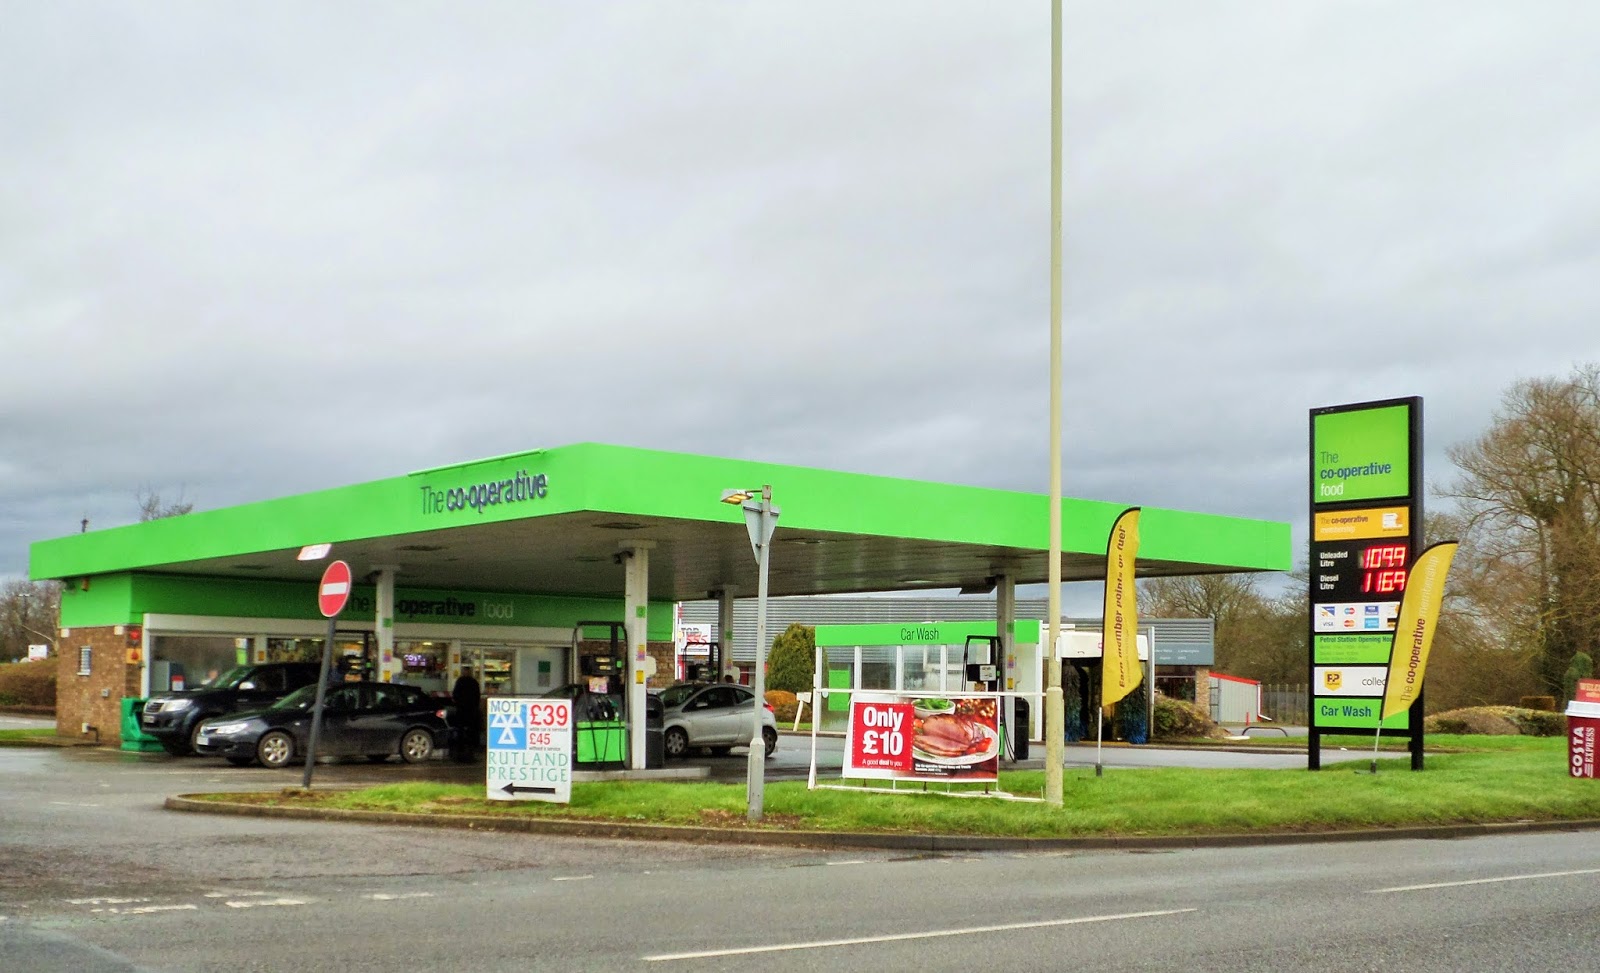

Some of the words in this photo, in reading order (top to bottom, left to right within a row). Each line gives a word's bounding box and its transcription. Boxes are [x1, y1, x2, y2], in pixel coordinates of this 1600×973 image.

[1320, 451, 1339, 464] The
[1320, 462, 1391, 480] co-operative
[421, 485, 444, 515] The
[446, 470, 548, 514] co-operative
[1320, 482, 1344, 497] food
[1331, 515, 1369, 524] co-operative
[1320, 550, 1348, 559] Unleaded
[1320, 574, 1339, 582] Diesel
[482, 599, 514, 619] food
[900, 628, 914, 641] Car
[916, 627, 940, 641] Wash
[1405, 617, 1426, 684] co-operative
[1361, 677, 1386, 686] collec
[1400, 685, 1413, 702] The
[490, 700, 519, 713] MOT
[1321, 705, 1338, 717] Car
[1342, 705, 1372, 717] Wash
[530, 704, 568, 726] £39
[863, 706, 904, 732] Only
[529, 732, 551, 745] £45
[862, 730, 903, 756] £10
[1585, 727, 1595, 763] EXPRESS
[488, 751, 568, 766] RUTLAND
[1572, 726, 1585, 777] COSTA
[867, 759, 878, 767] good
[488, 766, 568, 782] PRESTIGE
